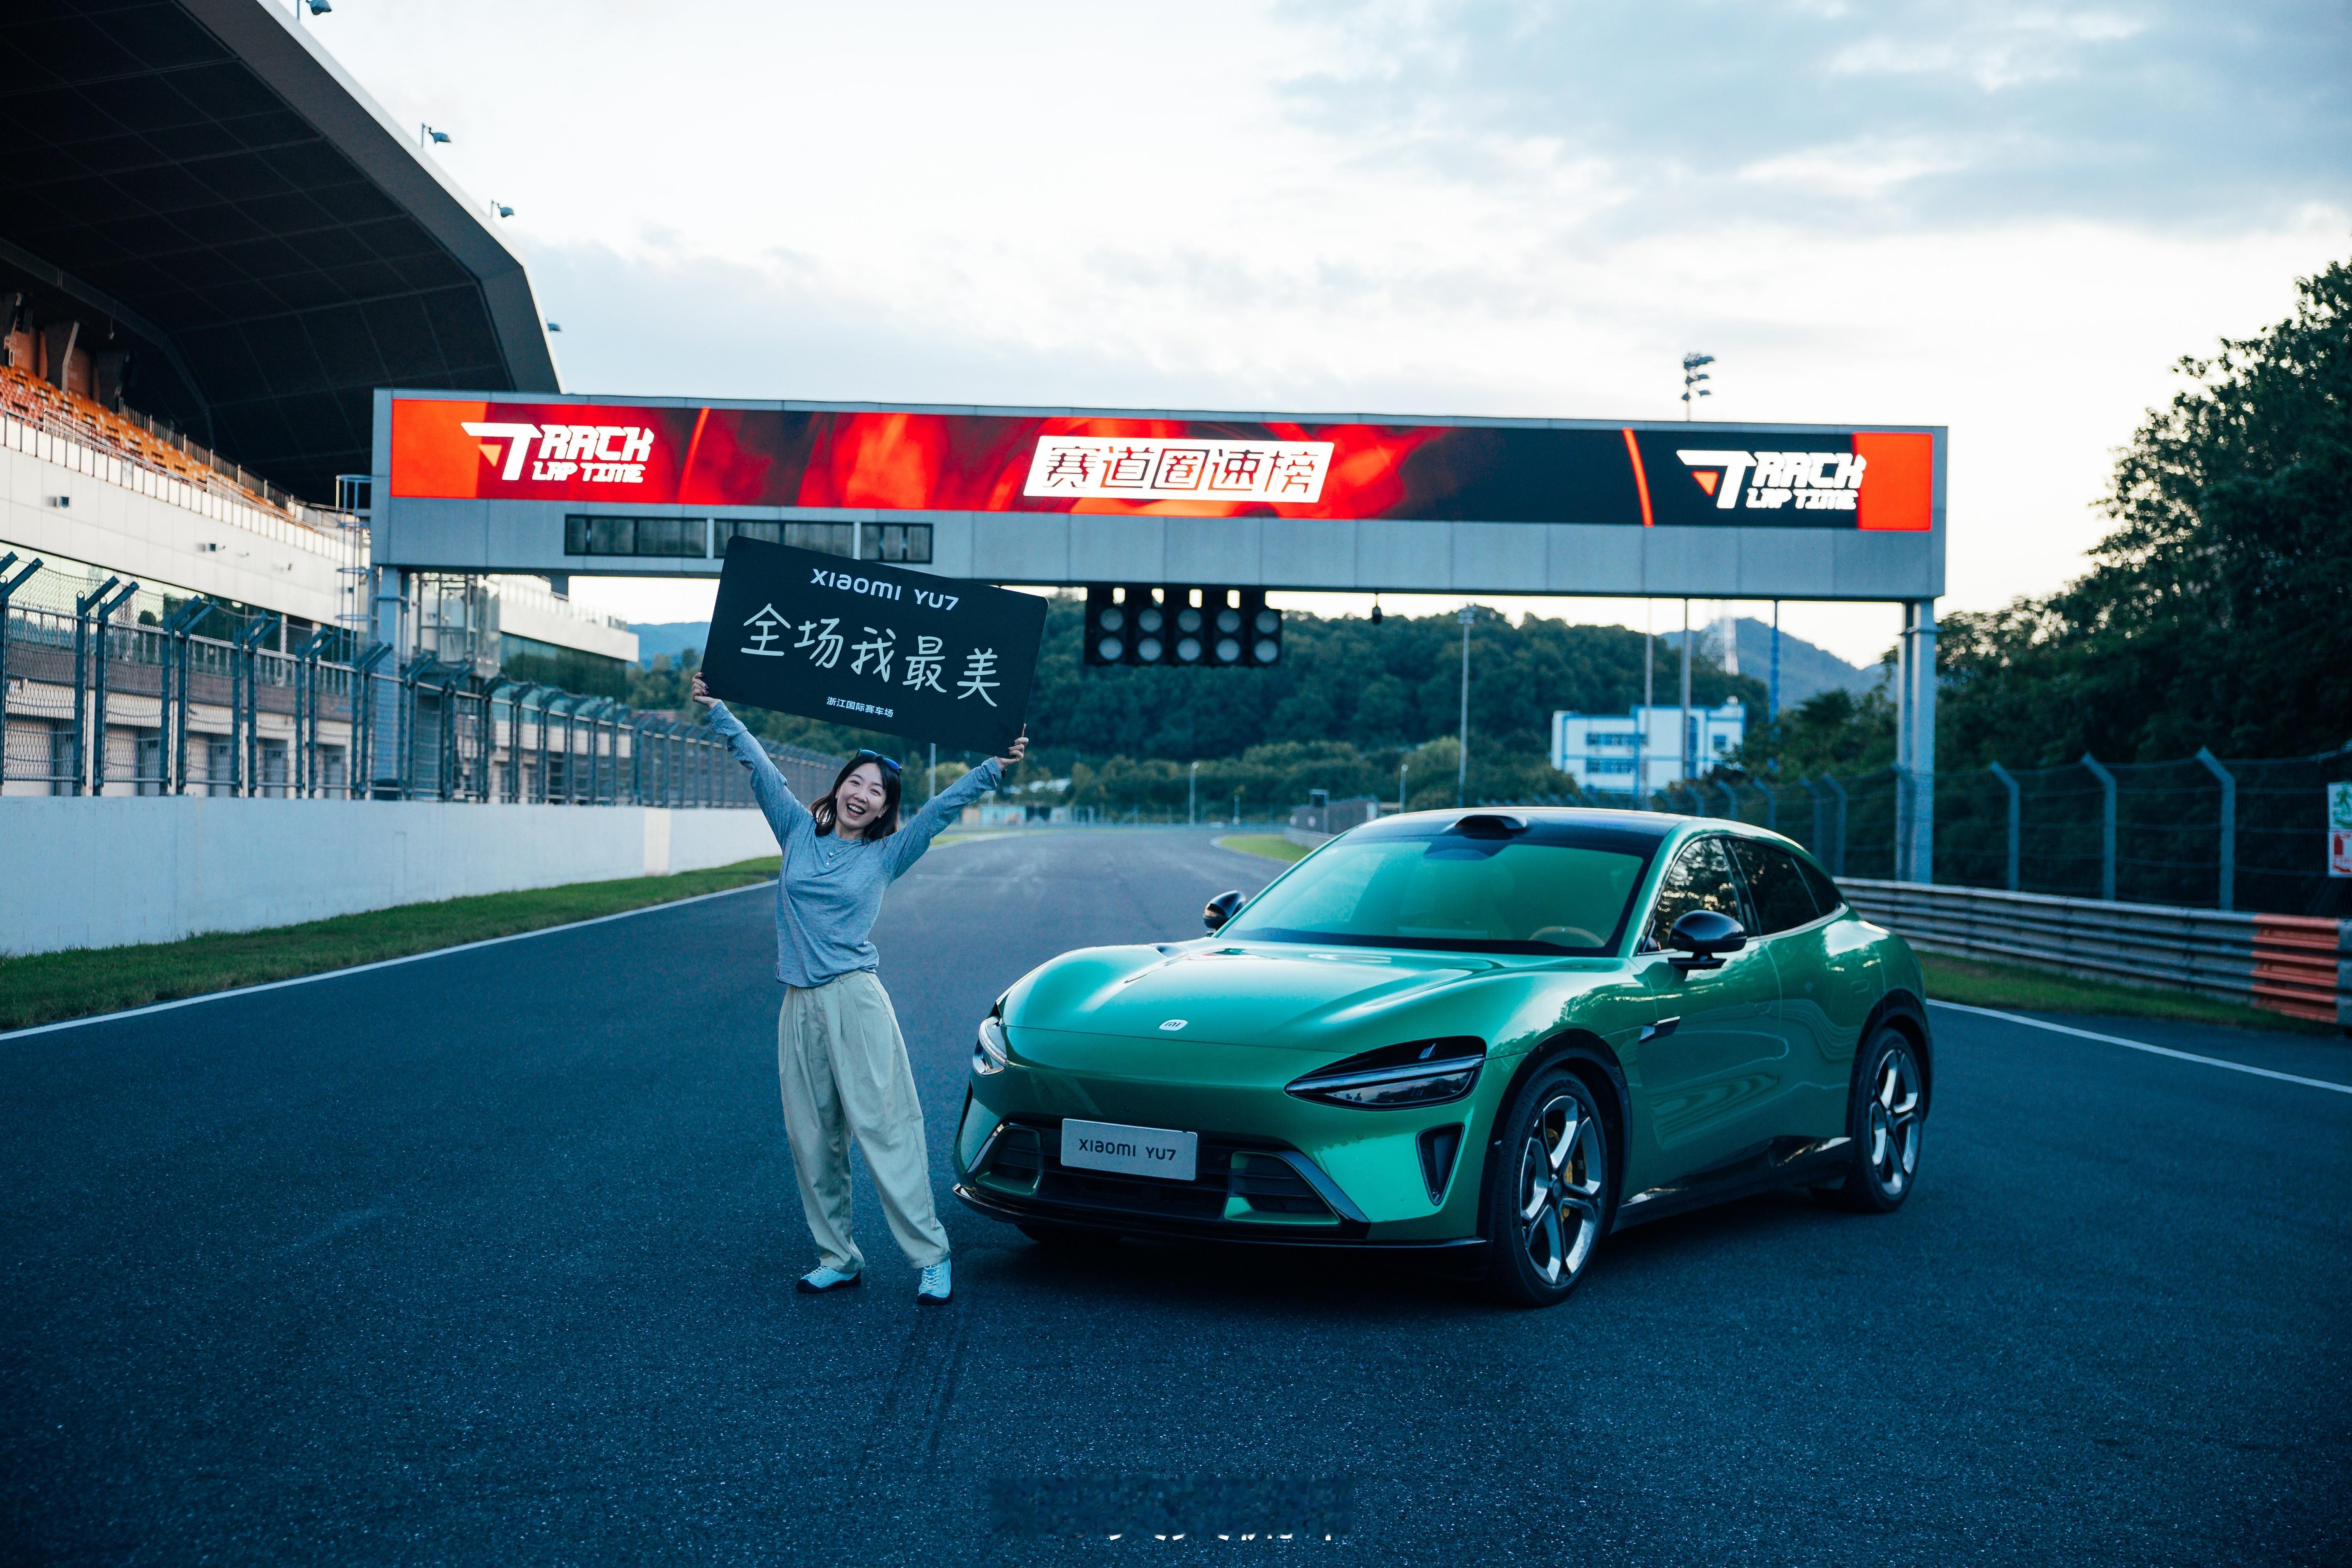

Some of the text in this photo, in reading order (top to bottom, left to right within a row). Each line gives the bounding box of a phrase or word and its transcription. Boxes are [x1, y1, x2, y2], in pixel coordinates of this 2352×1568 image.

[461, 422, 654, 481] TRACK
[532, 461, 646, 483] LAP TIME
[1042, 446, 1319, 493] 赛道圈速榜
[1676, 450, 1867, 509] TRACK
[1745, 488, 1858, 510] LAP TIME
[914, 589, 959, 610] YU7
[741, 603, 1000, 707] 全场我最美
[827, 696, 893, 718] 浙江国际赛车场
[1145, 1146, 1176, 1161] YU7
